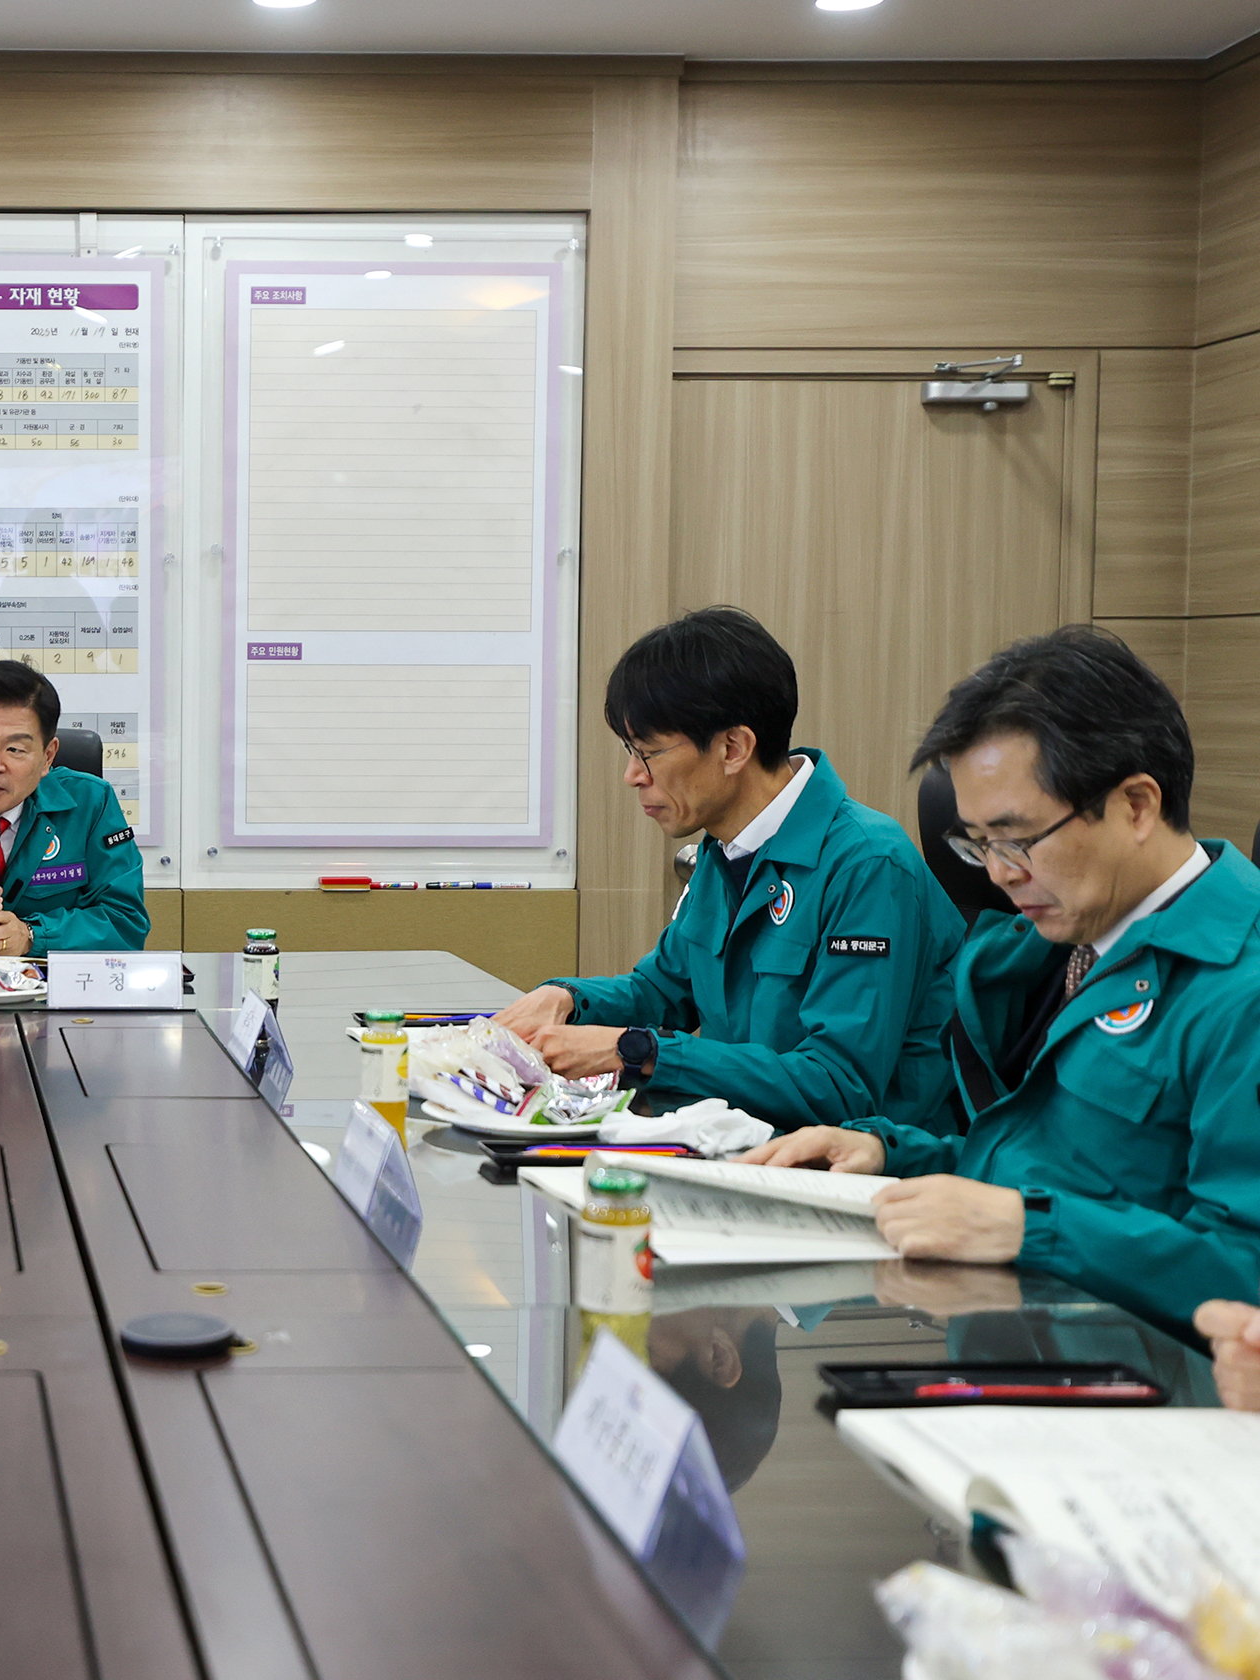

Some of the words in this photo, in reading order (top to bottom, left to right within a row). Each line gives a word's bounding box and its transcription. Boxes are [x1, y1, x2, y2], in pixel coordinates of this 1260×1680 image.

[10, 288, 41, 306] 자재
[48, 288, 80, 306] 현황
[254, 291, 270, 300] 주요
[272, 291, 303, 301] 조치사항
[125, 328, 139, 336] 현재
[251, 647, 266, 656] 주요
[269, 646, 299, 656] 민원현황
[831, 940, 848, 950] 서울
[850, 940, 886, 952] 동대문구
